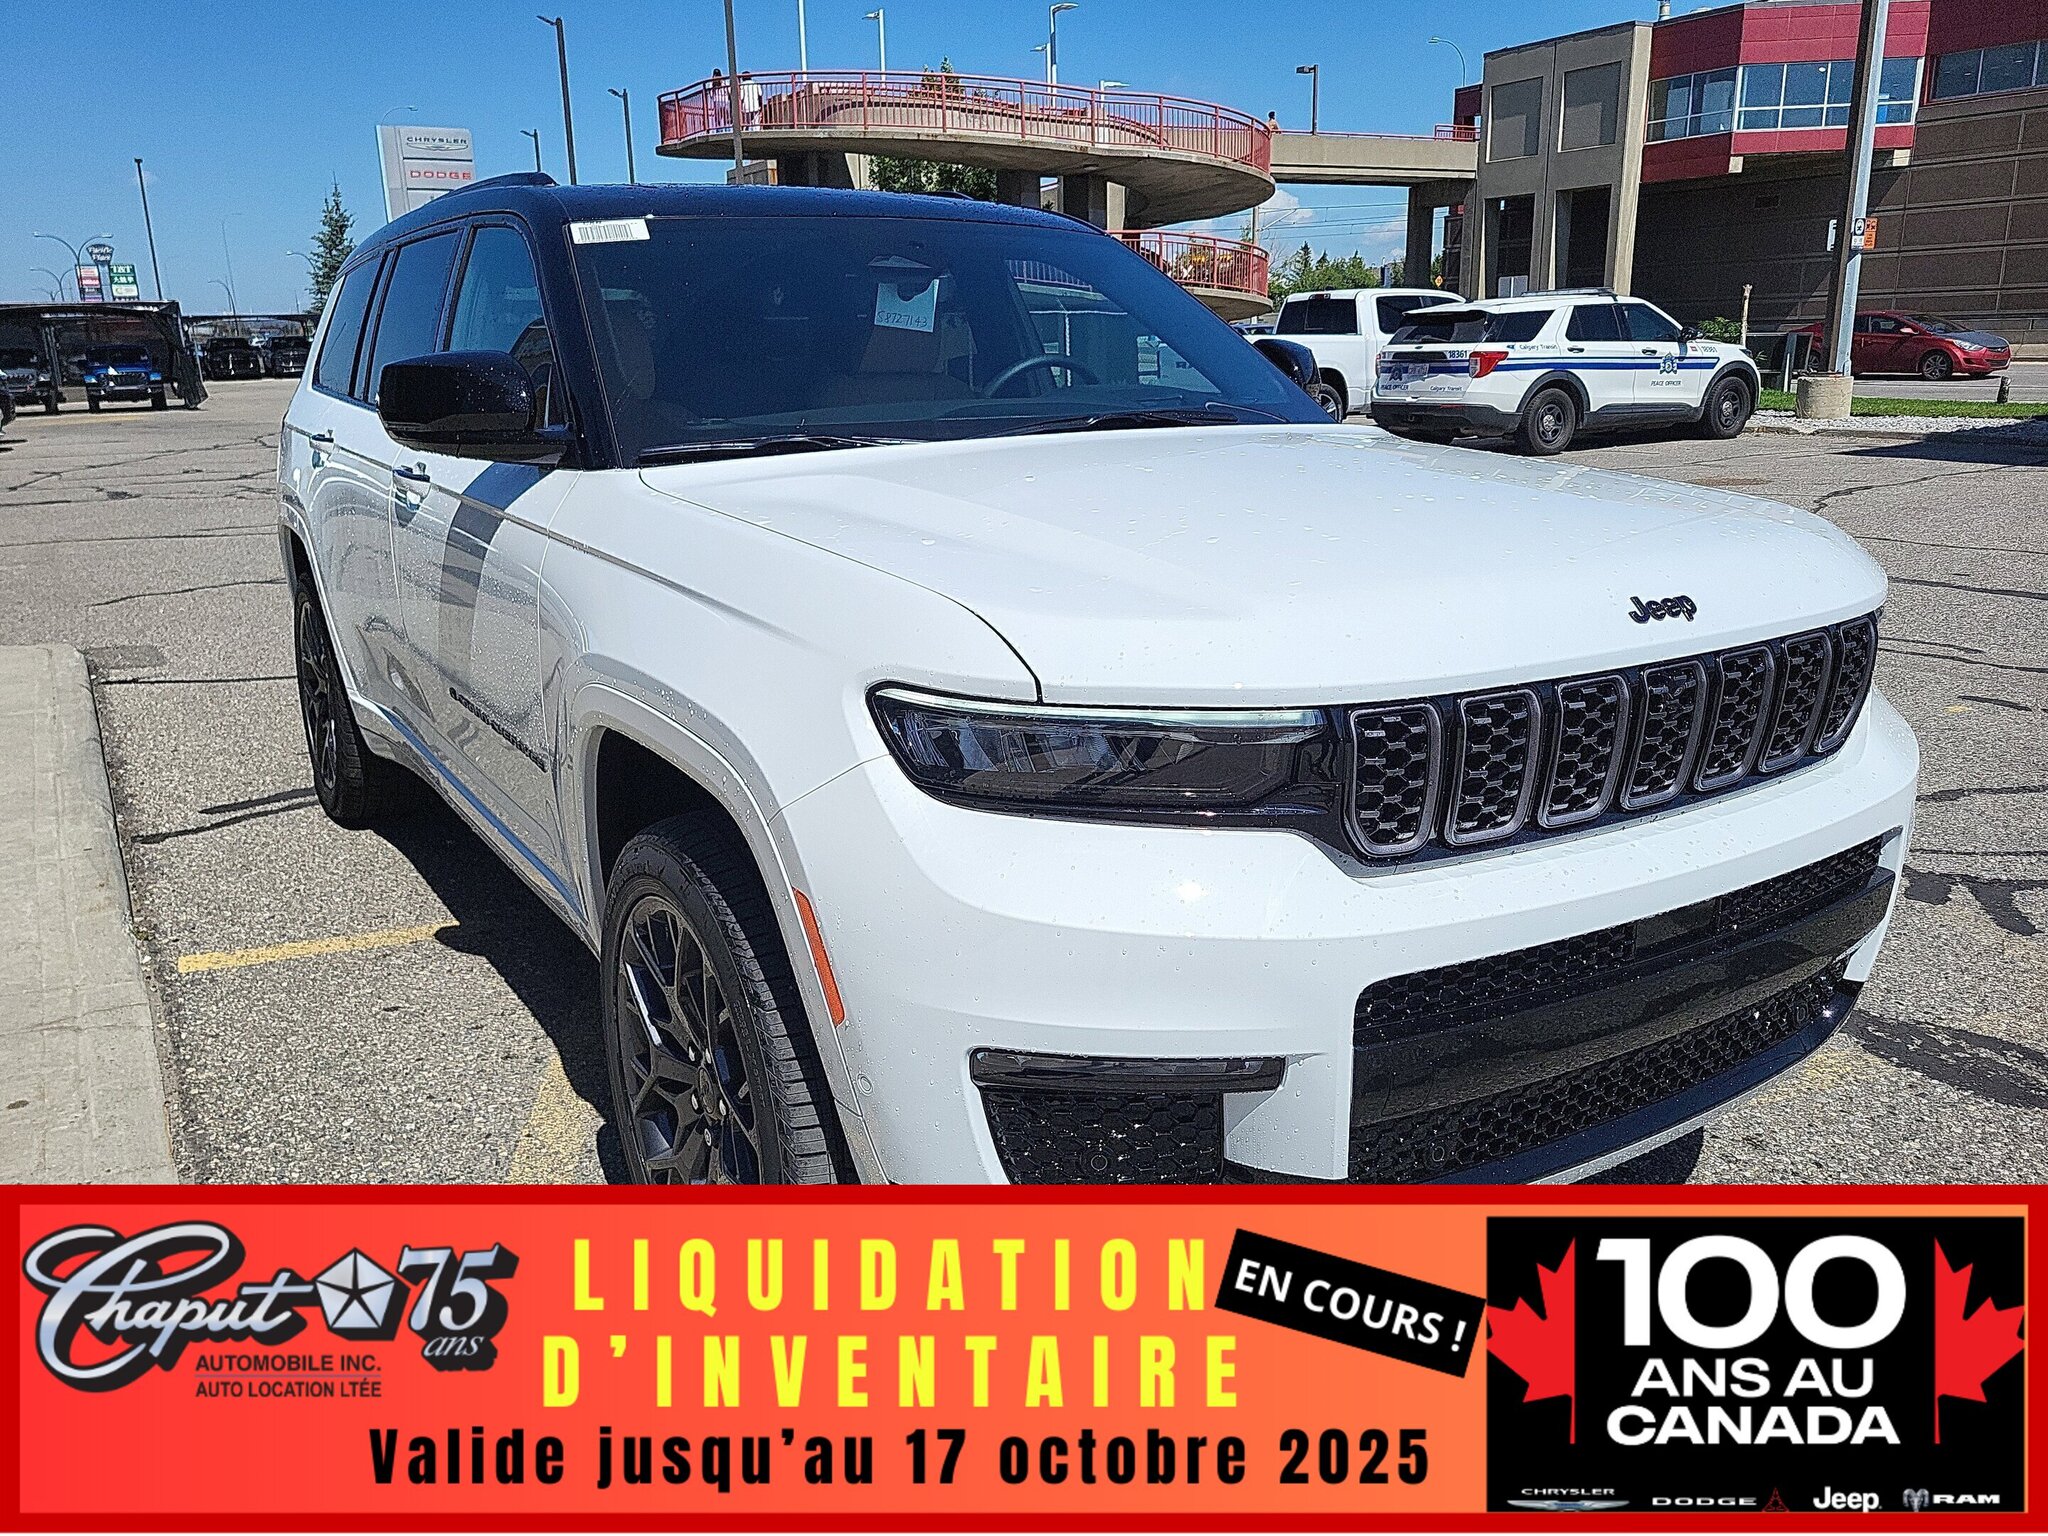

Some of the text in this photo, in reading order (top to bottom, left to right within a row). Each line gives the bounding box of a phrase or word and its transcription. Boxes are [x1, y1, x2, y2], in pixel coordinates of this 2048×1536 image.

[406, 136, 467, 145] CHRYSLER
[410, 170, 471, 180] DODGE
[1448, 350, 1468, 359] 18361
[1628, 595, 1697, 624] Jeep
